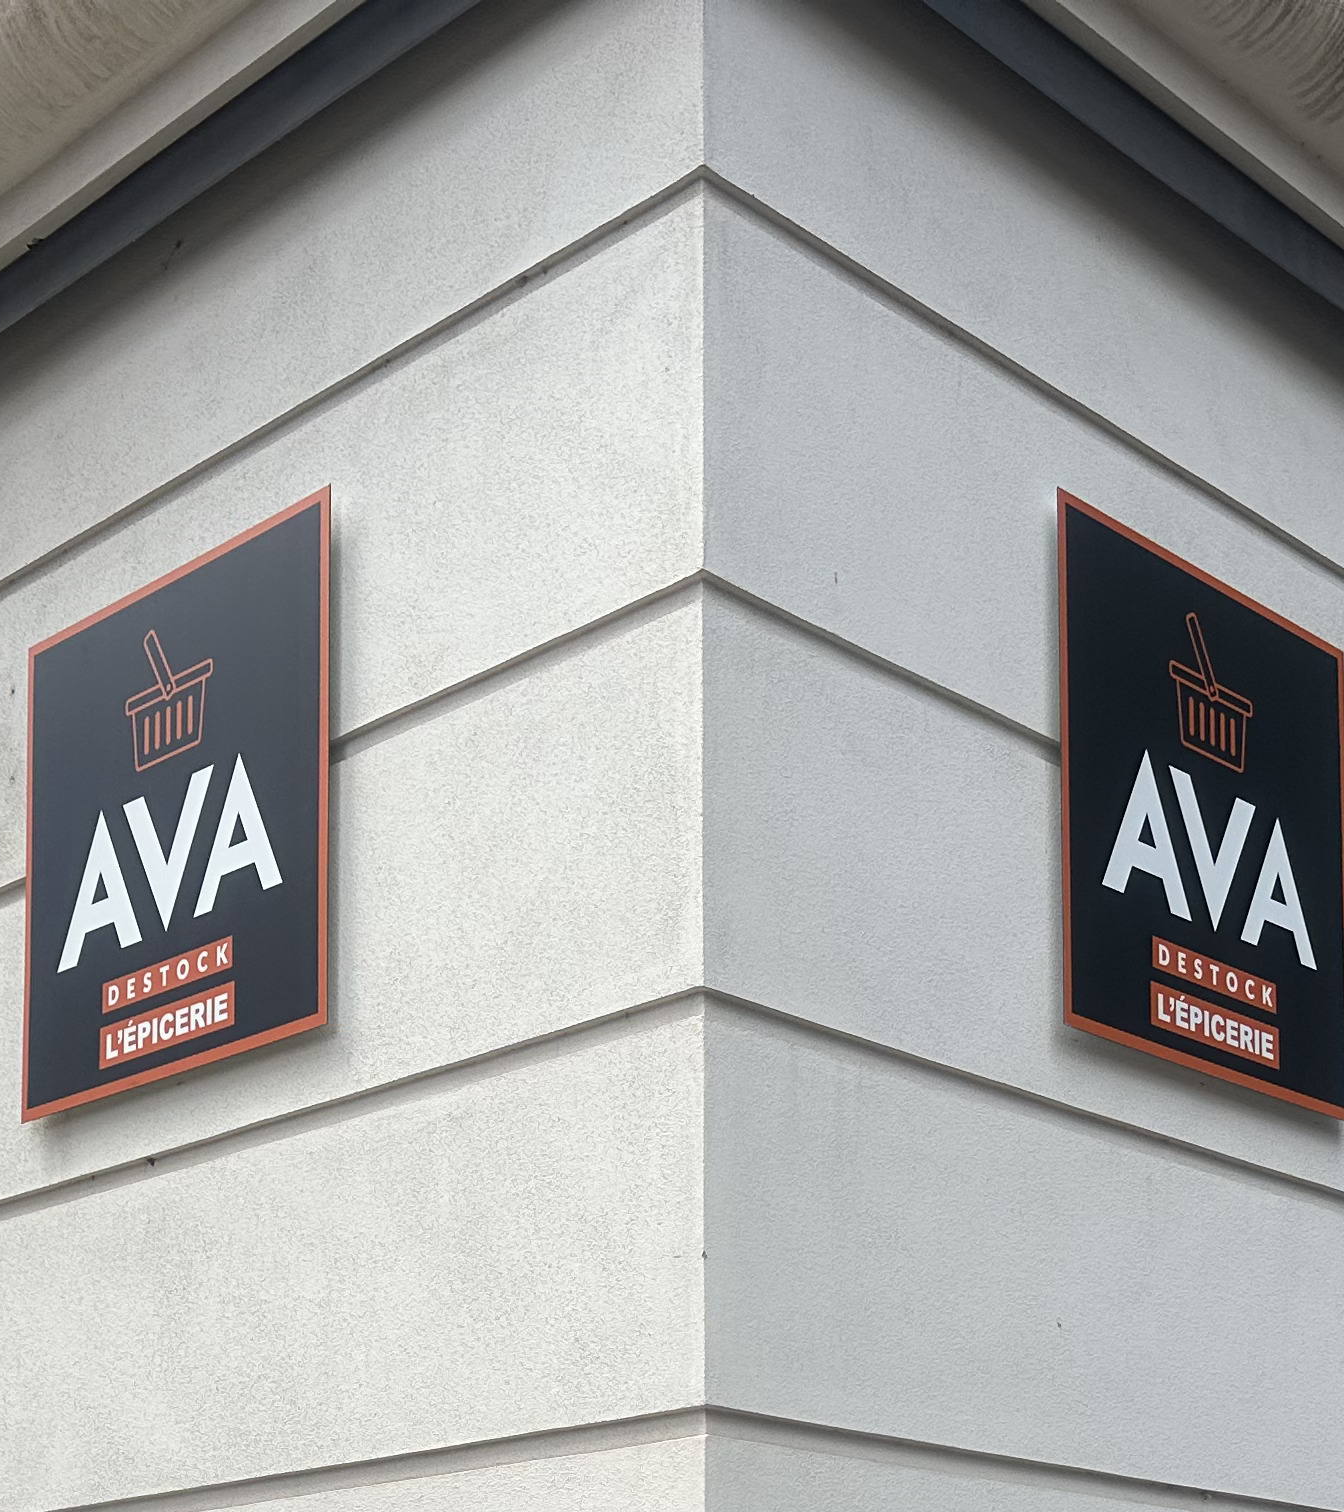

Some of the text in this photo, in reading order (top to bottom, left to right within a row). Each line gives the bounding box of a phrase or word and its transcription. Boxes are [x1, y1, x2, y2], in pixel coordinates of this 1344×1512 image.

[57, 752, 283, 974] AVA
[1101, 748, 1318, 971] AVA
[107, 942, 229, 1007] DESTOCK
[1158, 943, 1273, 1008] DESTOCK
[105, 992, 229, 1061] L'ÉPICERIE
[1157, 992, 1275, 1061] L'ÉPICERIE
